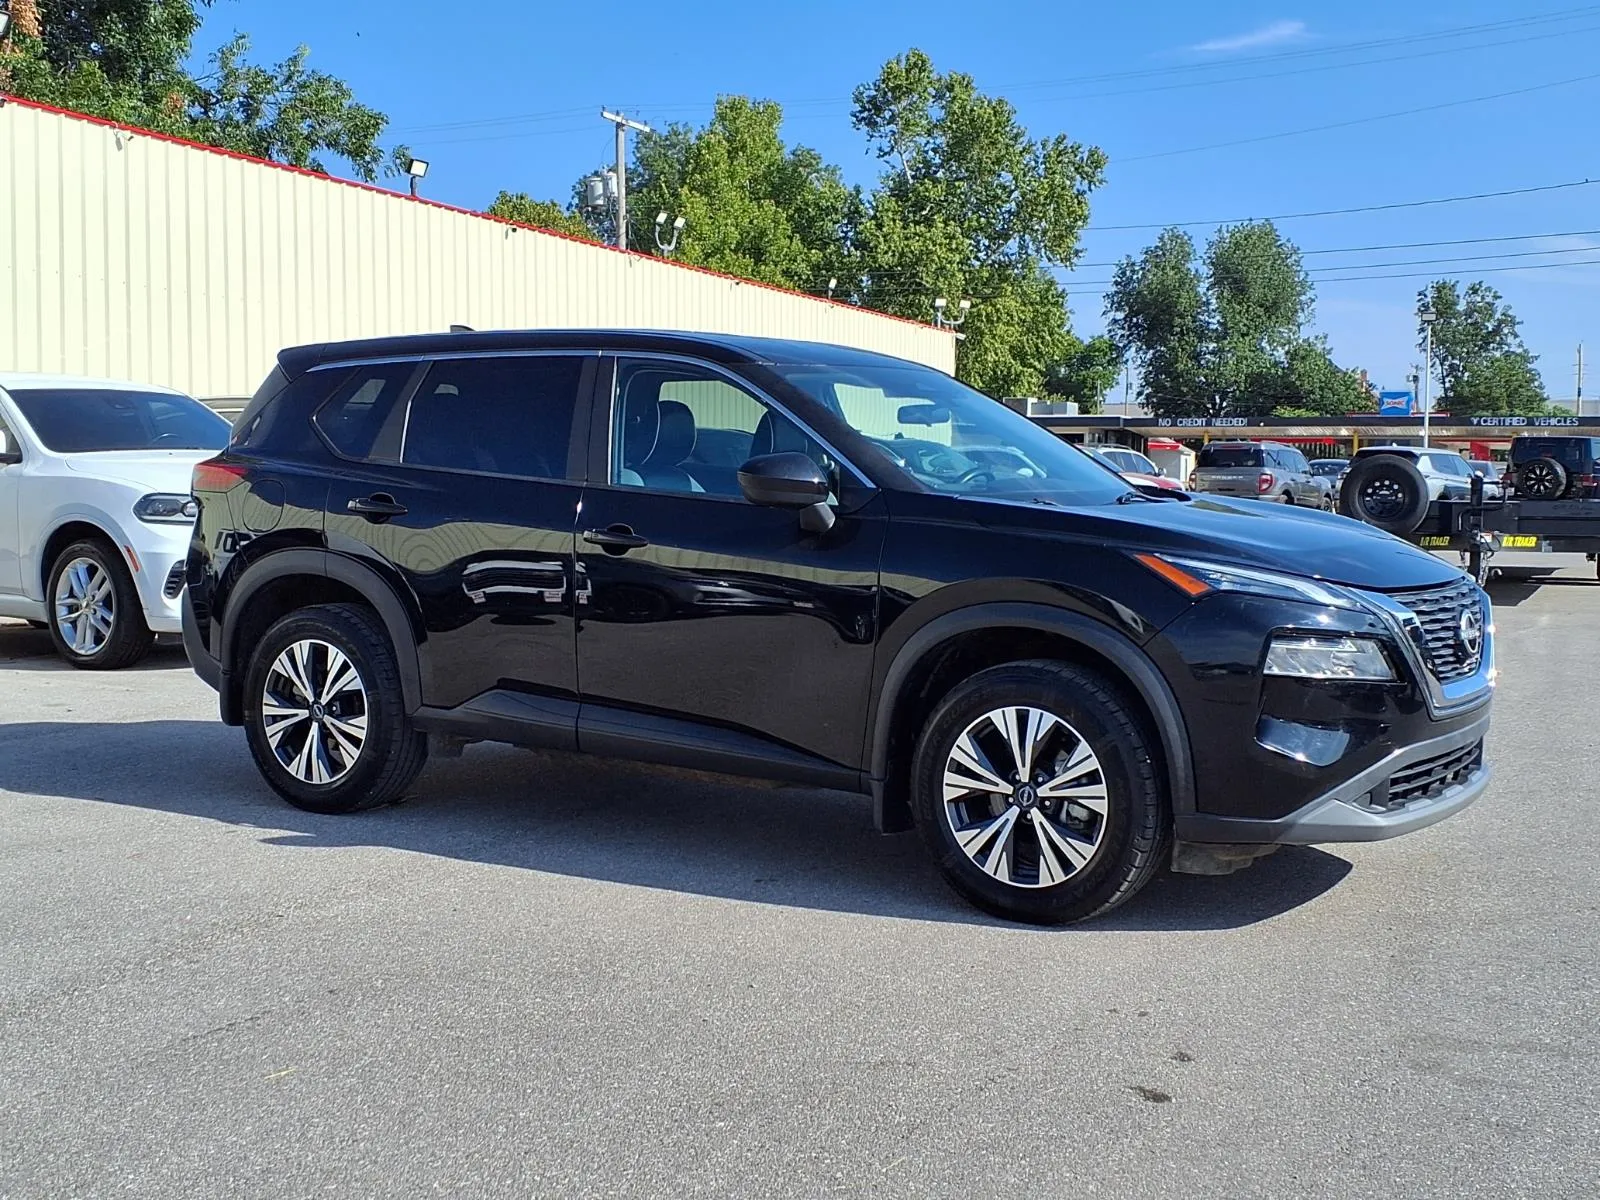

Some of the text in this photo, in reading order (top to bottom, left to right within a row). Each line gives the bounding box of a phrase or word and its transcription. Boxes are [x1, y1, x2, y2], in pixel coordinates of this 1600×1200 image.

[1158, 417, 1248, 426] NO CREDIT NEEDED!
[1533, 416, 1579, 426] VEHICLES
